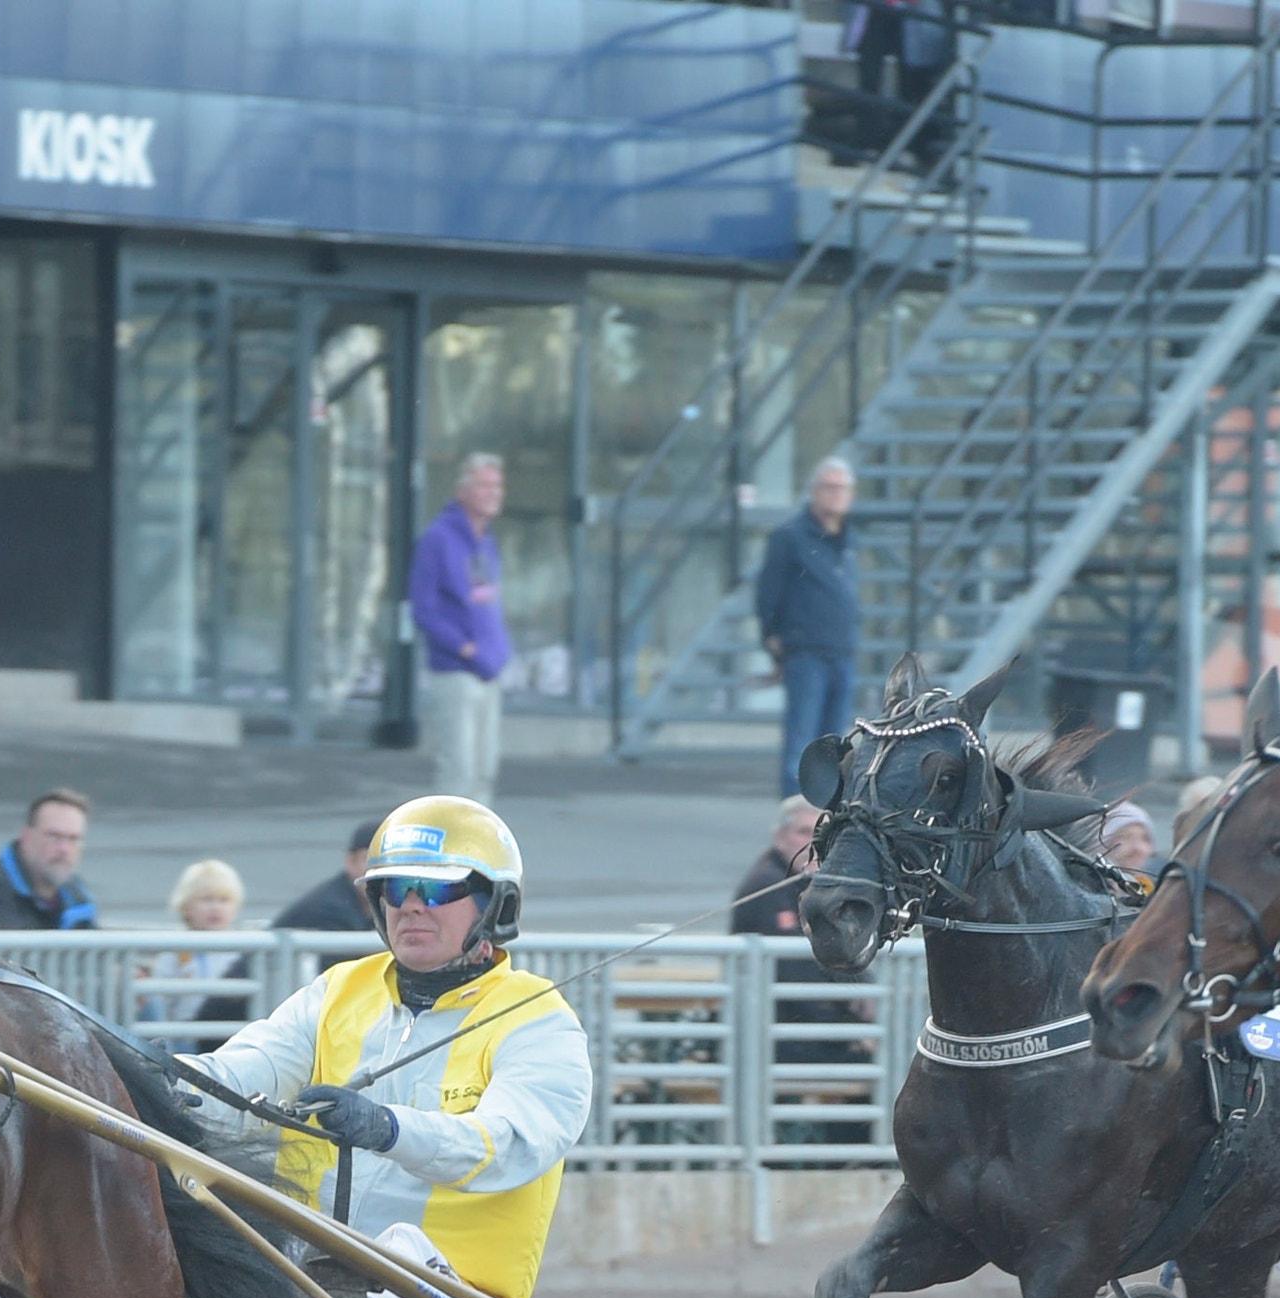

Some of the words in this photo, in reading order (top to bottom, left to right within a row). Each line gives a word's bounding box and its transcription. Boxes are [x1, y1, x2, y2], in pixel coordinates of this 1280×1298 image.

[17, 108, 155, 188] KIOSK
[925, 1035, 959, 1060] STALL
[960, 1035, 1049, 1061] SJÖSTRÖM
